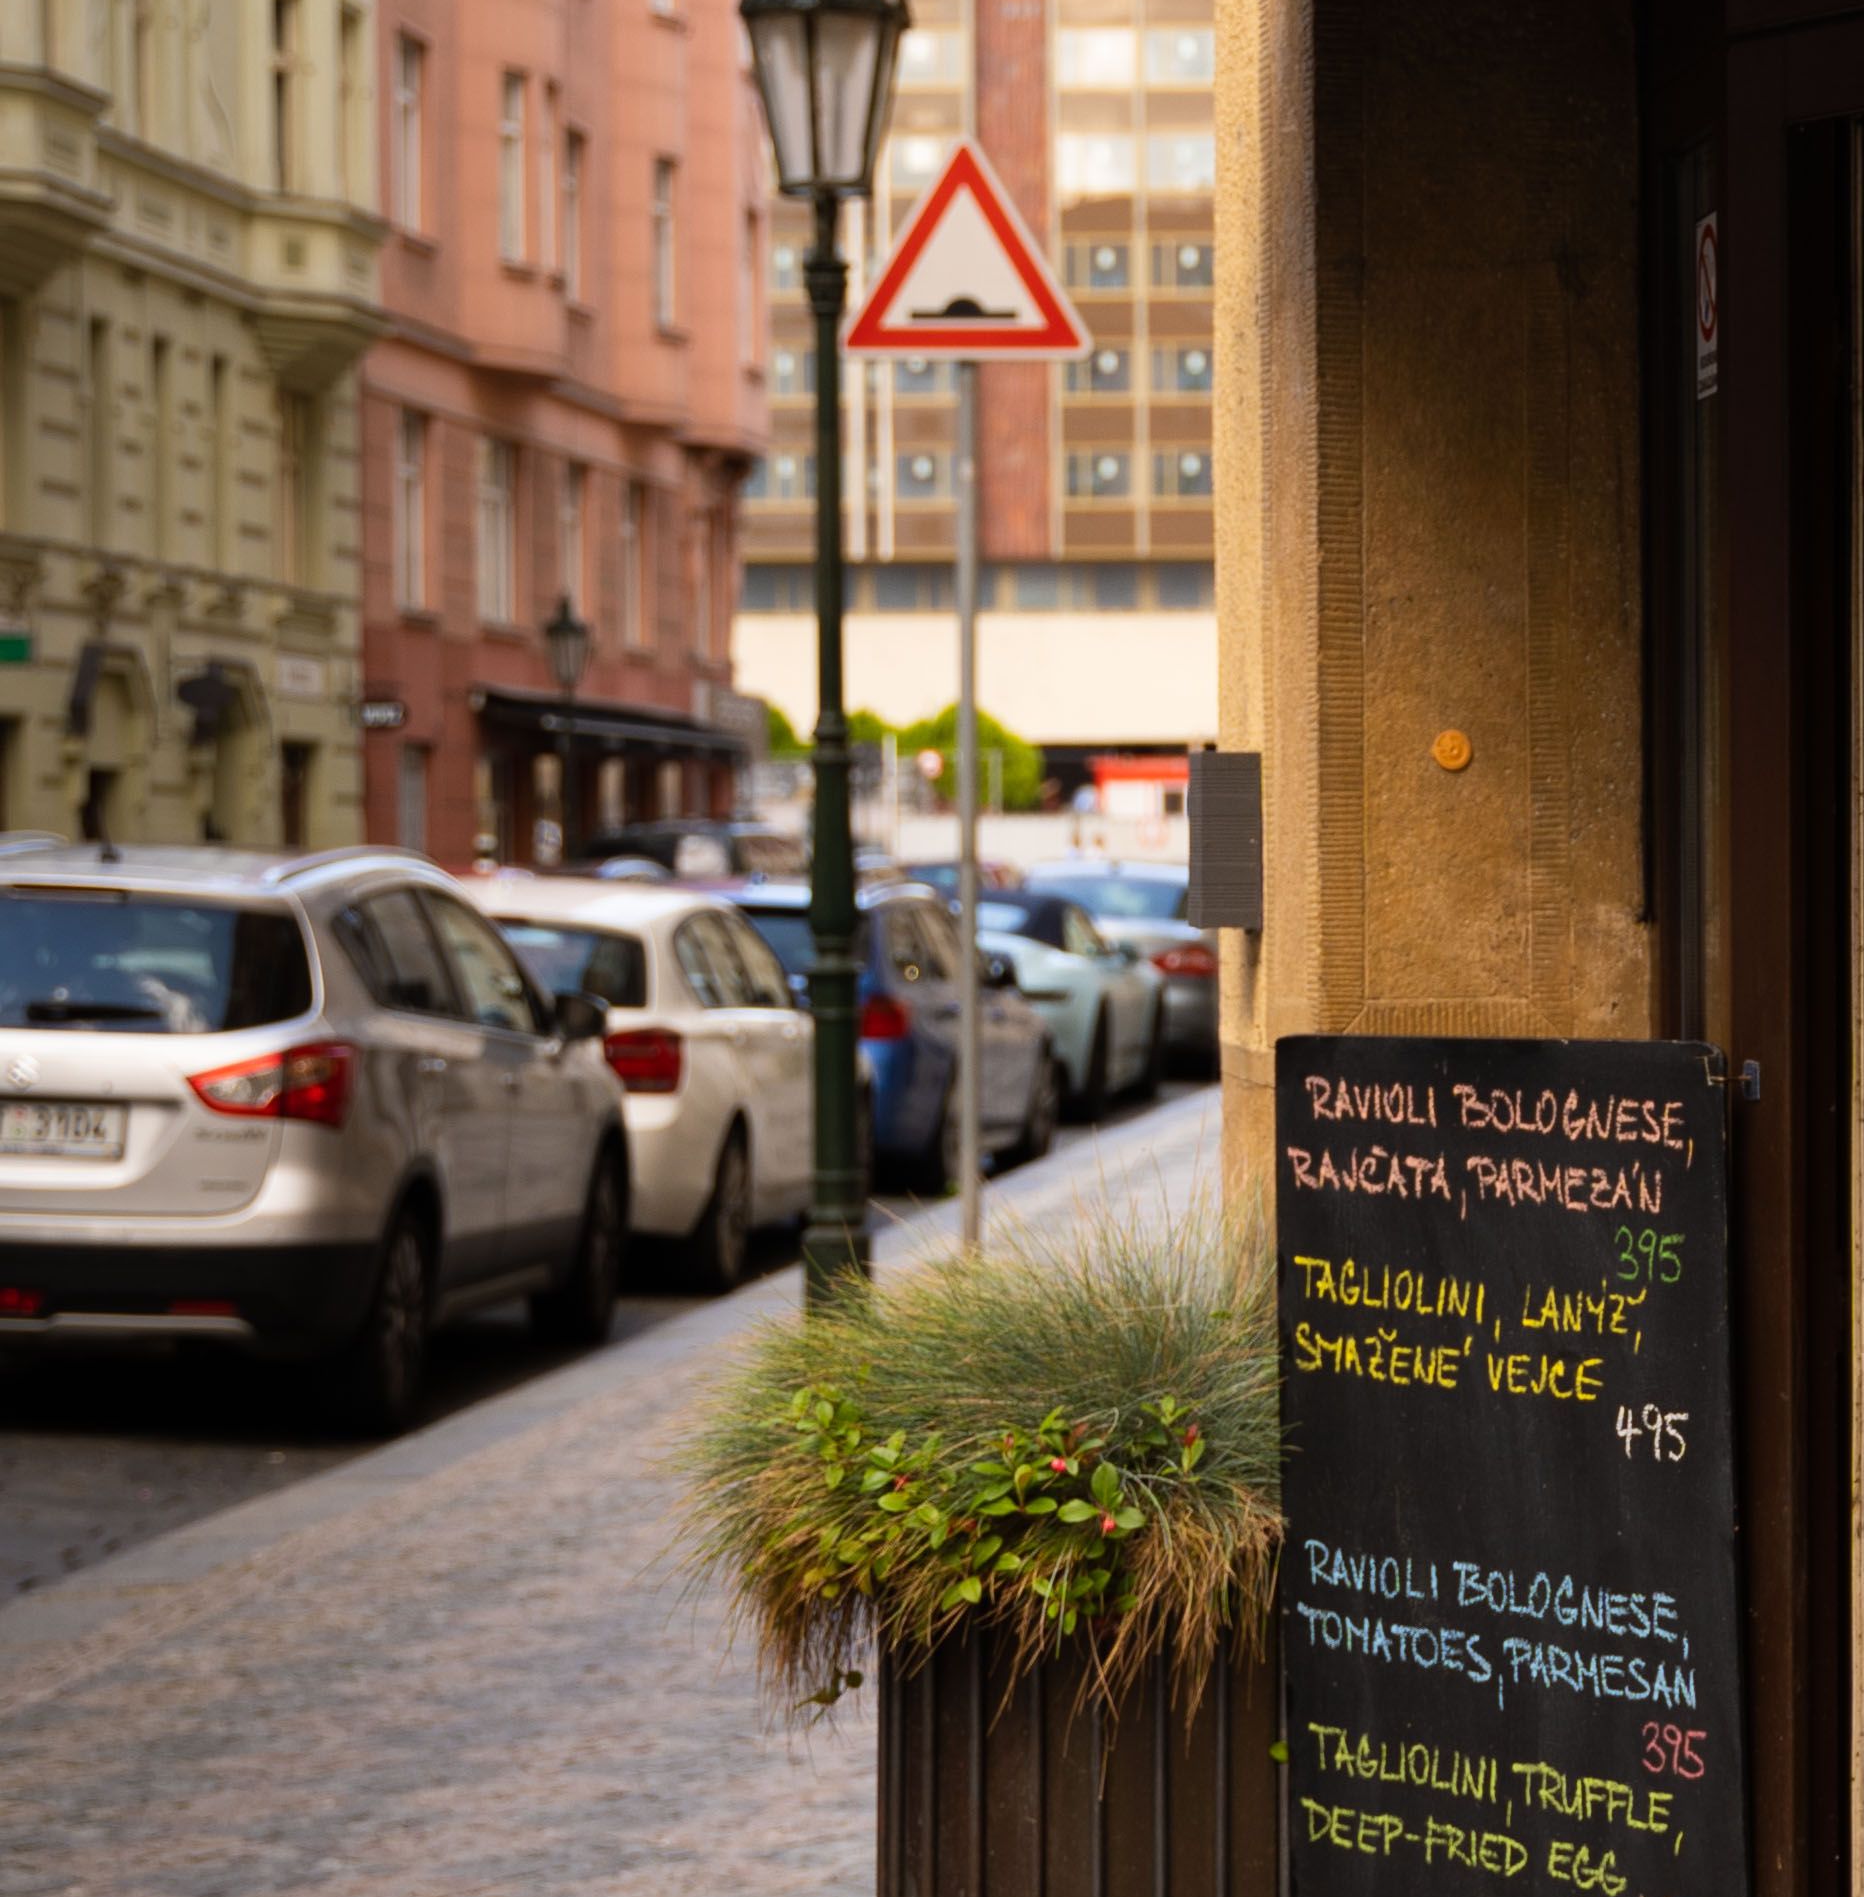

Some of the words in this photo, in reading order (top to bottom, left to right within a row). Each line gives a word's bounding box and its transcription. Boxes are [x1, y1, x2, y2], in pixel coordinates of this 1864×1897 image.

[1306, 1076, 1436, 1127] RAVIOLI
[1453, 1084, 1693, 1168] BOLOGNESE,
[1295, 1255, 1500, 1342] TAGLIOLINI,
[1614, 1226, 1685, 1282] 395
[1487, 1353, 1604, 1401] VEJCE
[1616, 1404, 1689, 1461] 495
[1305, 1539, 1437, 1600] RAVIOLI
[1453, 1561, 1688, 1659] BOLOGNESE,
[1297, 1601, 1504, 1711] TOMATOES,
[1503, 1637, 1696, 1709] PARMESAN
[1308, 1721, 1512, 1826] TAGLIOLINI,
[1512, 1761, 1683, 1856] TRUFFLE,
[1641, 1721, 1707, 1778] 395
[1301, 1797, 1527, 1877] DEEP-FRIED
[1547, 1839, 1627, 1897] EGG
